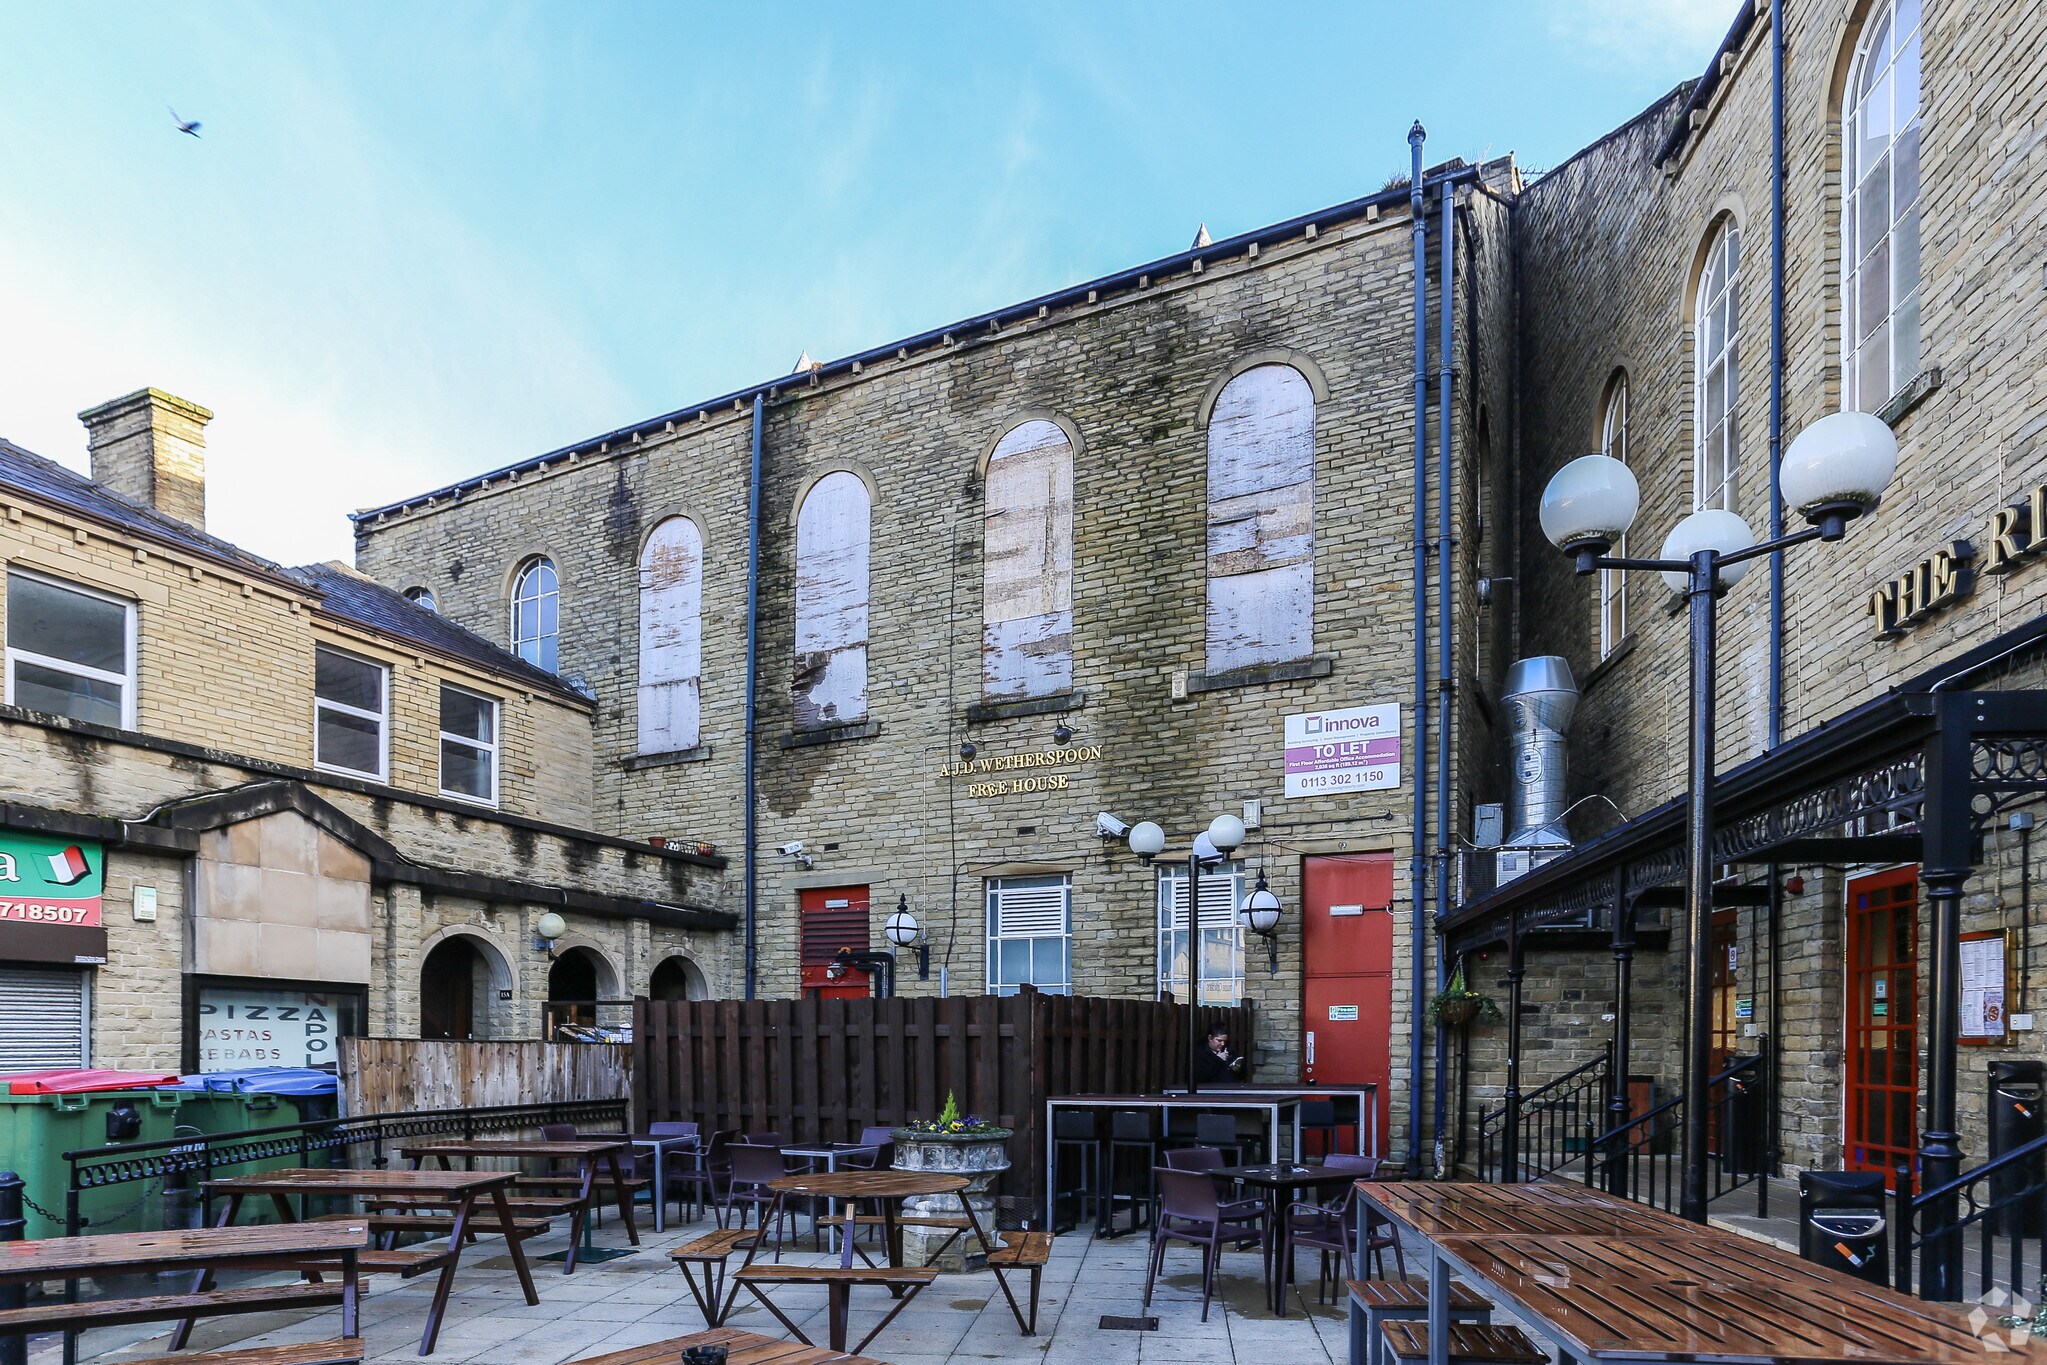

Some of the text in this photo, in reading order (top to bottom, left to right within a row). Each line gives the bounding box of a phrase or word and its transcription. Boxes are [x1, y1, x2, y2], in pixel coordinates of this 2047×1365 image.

[1867, 540, 1974, 641] THE
[1325, 715, 1379, 732] innova
[980, 745, 1103, 772] WETHERSPOON
[1313, 741, 1370, 758] TO LET
[968, 774, 1070, 798] FREE HOUSE
[1301, 770, 1384, 788] 0113 302 1150
[0, 901, 88, 923] 718507
[200, 1029, 272, 1041] ASTAS
